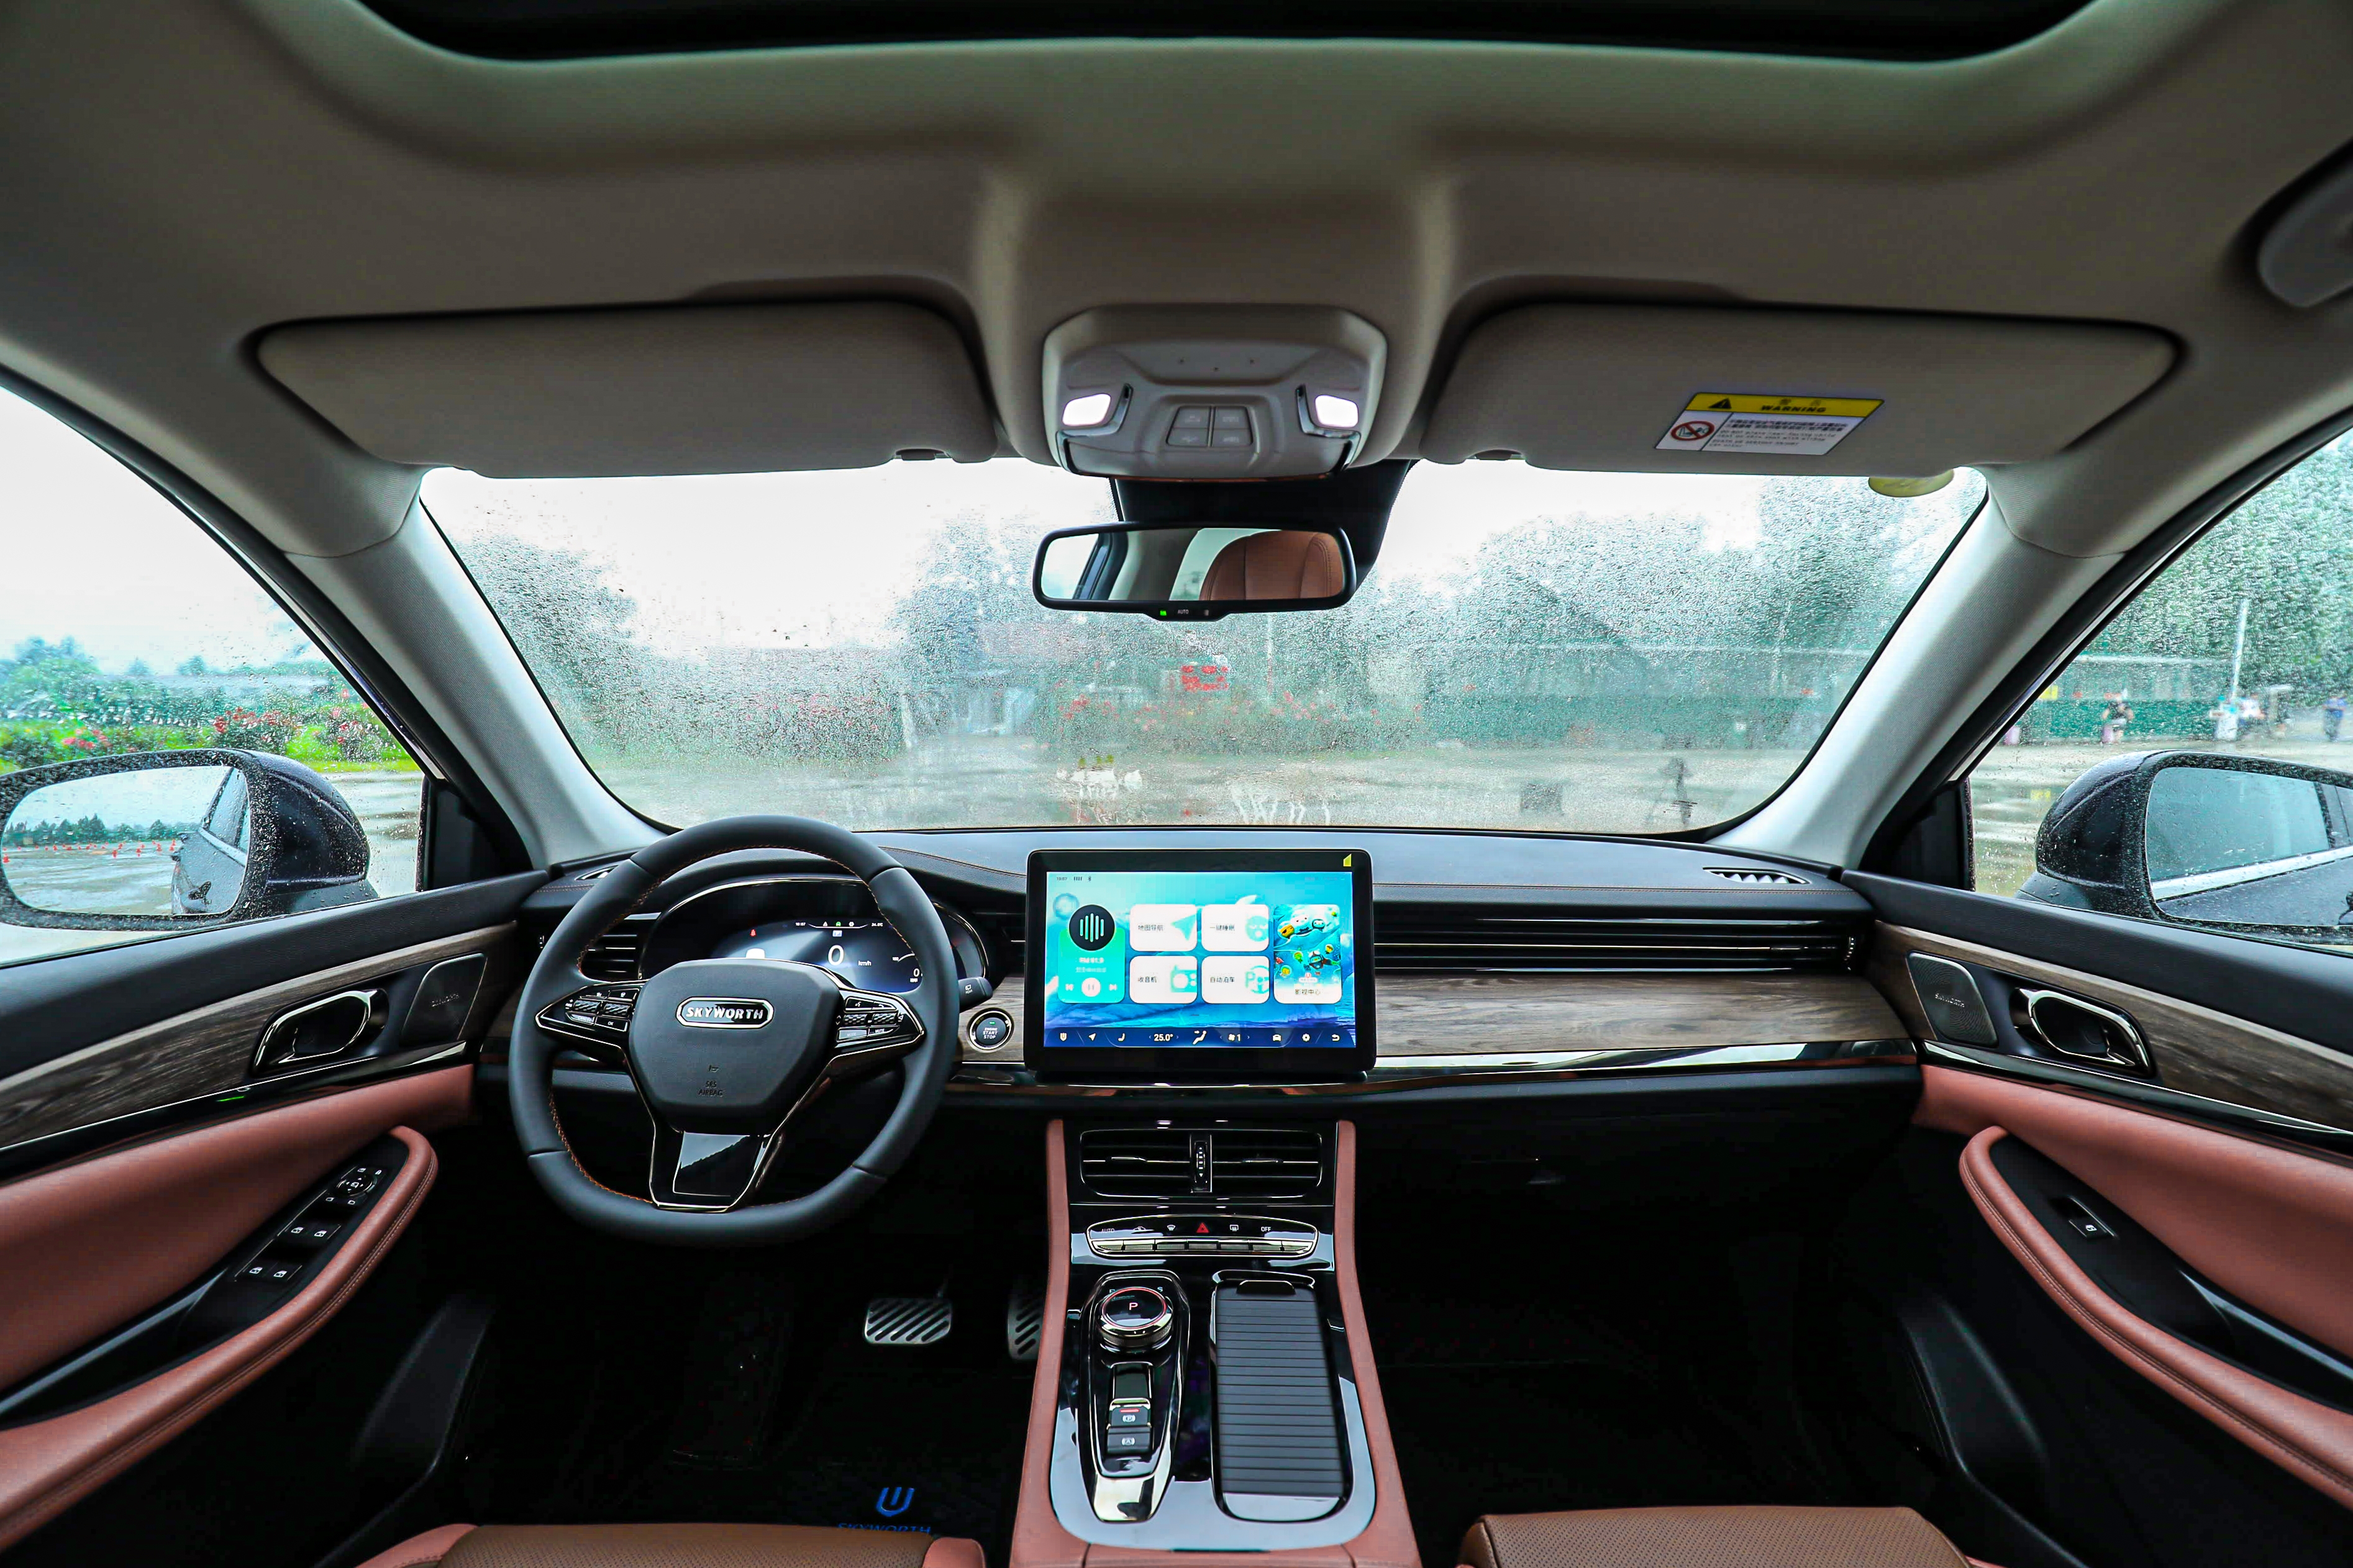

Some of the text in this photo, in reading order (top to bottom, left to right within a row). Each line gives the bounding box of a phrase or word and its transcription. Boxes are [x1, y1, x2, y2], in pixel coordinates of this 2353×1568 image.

[827, 945, 845, 966] 0
[913, 968, 920, 977] 0
[686, 1006, 763, 1020] SKYWORTH
[1129, 1302, 1138, 1311] P
